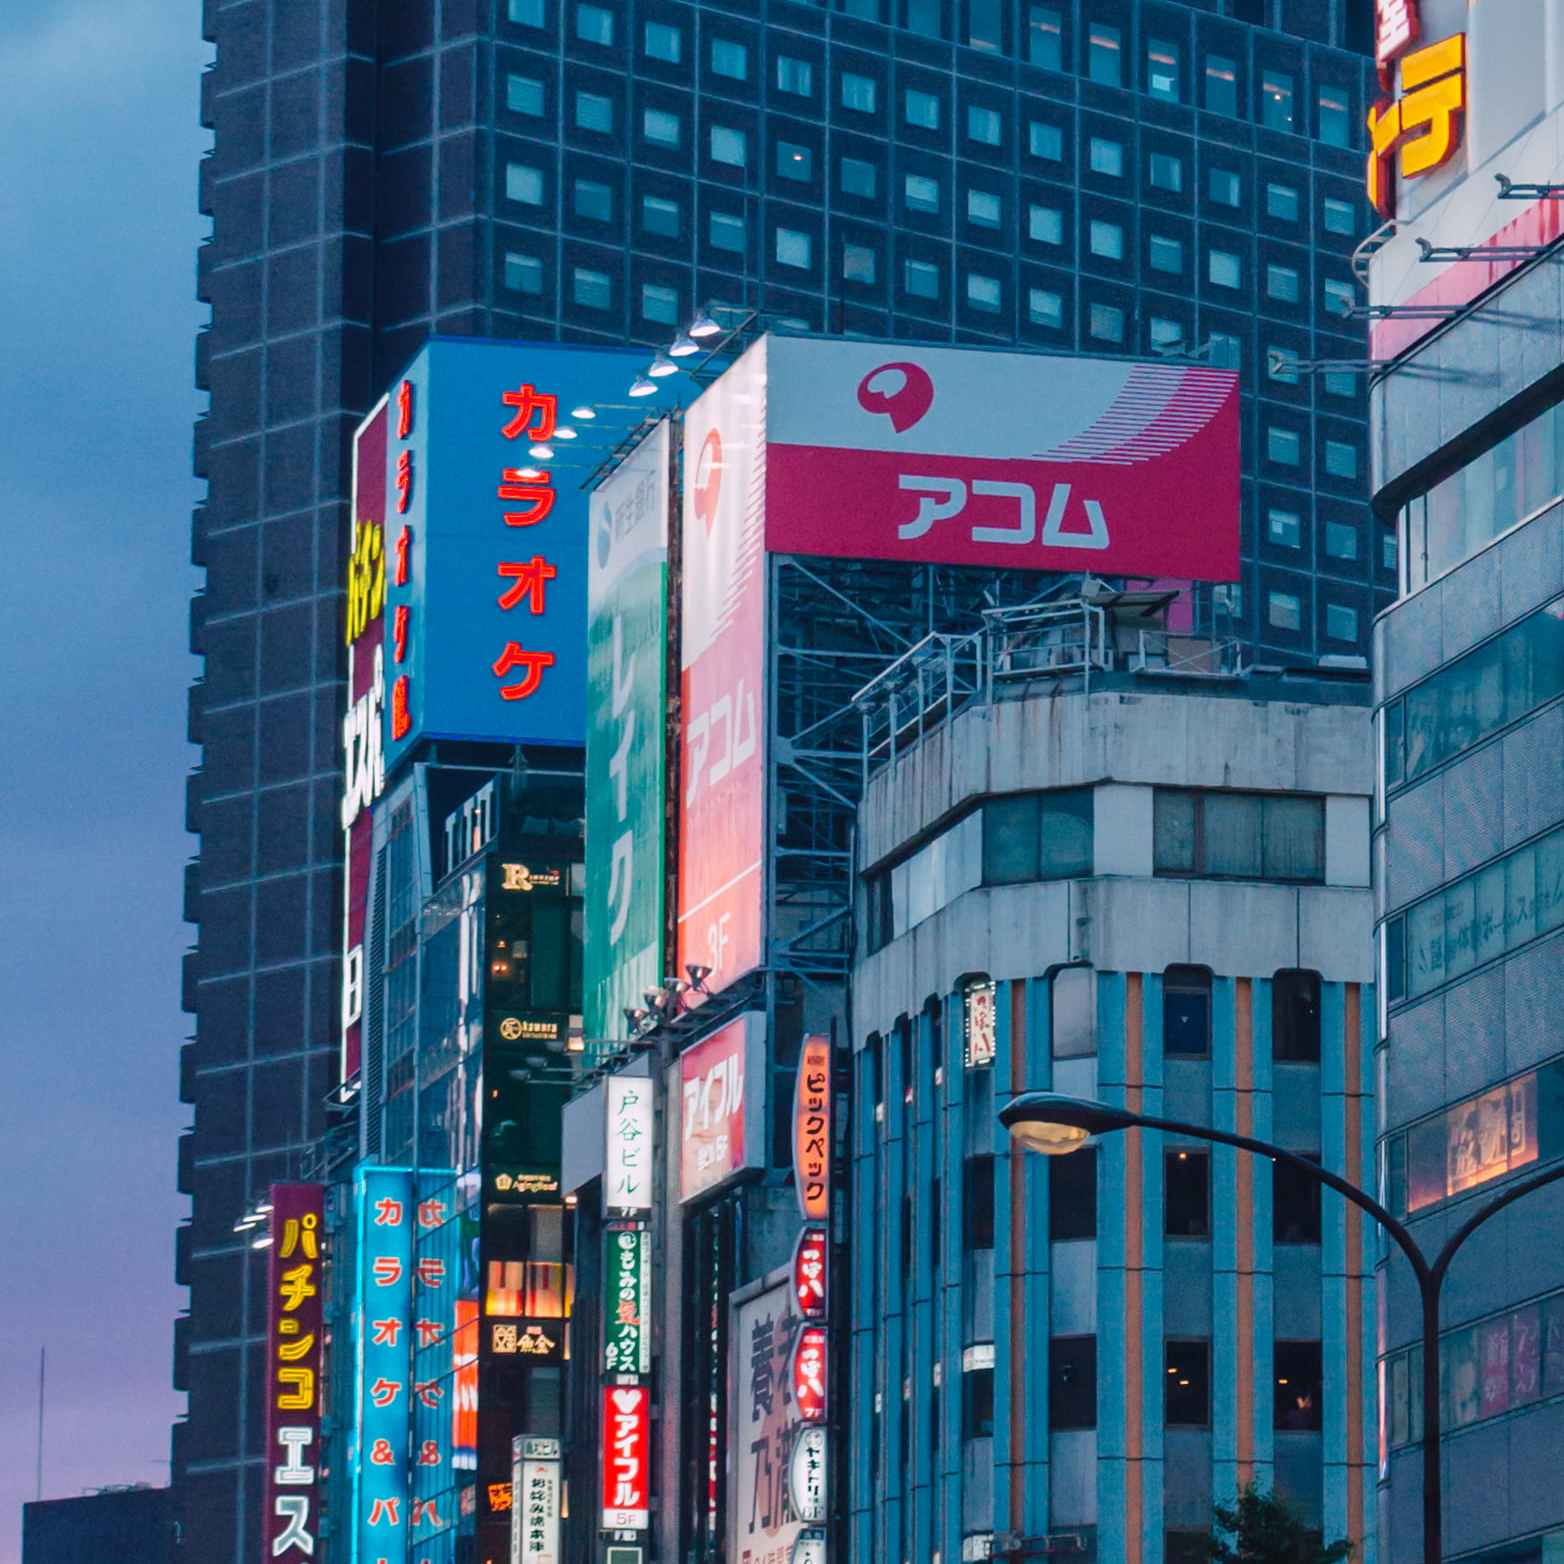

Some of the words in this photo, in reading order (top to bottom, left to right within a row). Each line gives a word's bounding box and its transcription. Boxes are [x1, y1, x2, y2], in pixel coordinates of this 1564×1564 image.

[493, 383, 559, 701] カラオケ
[898, 474, 1110, 549] アコム
[609, 613, 637, 945] レイク
[685, 678, 757, 806] アコム
[707, 913, 730, 977] 3F
[617, 1090, 643, 1195] 戸谷ビル
[684, 1052, 743, 1141] アイフル
[279, 1214, 318, 1410] パチンコ
[618, 1251, 640, 1372] もみの気ハウス
[614, 1415, 640, 1506] アイフル
[616, 1513, 637, 1526] 5F
